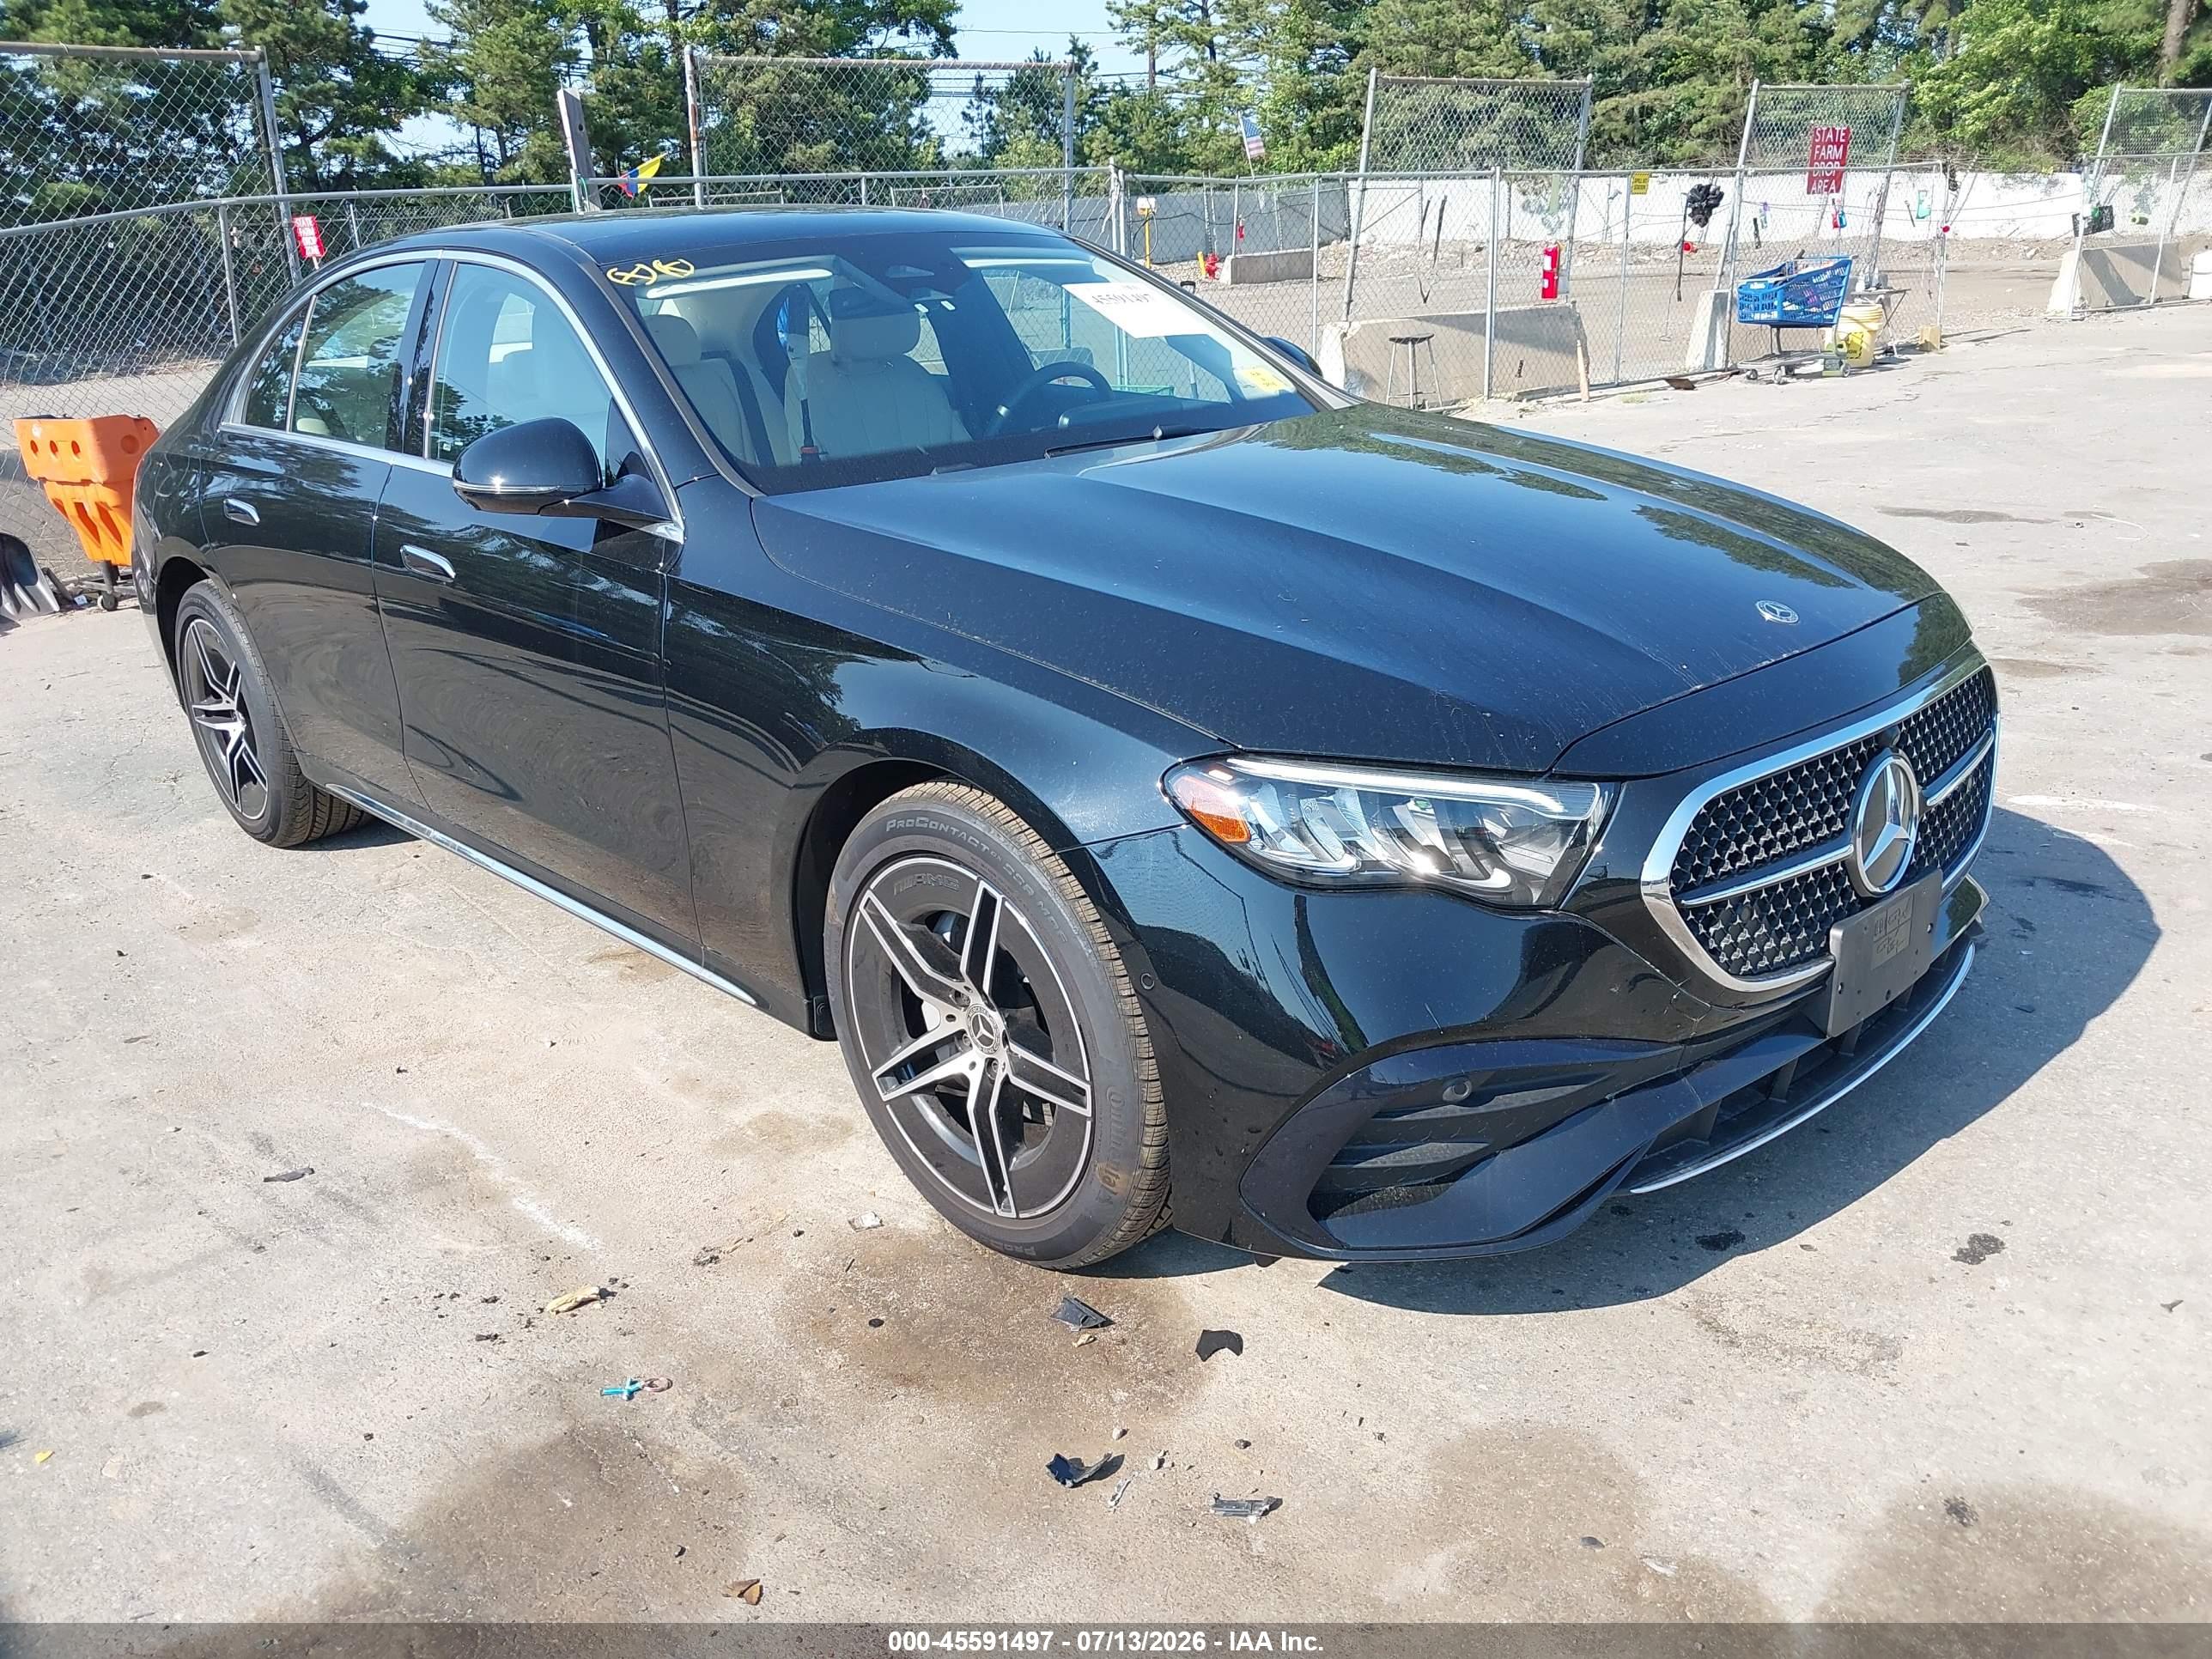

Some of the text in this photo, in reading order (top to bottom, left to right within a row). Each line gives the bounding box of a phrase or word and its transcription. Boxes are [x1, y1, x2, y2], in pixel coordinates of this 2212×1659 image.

[1814, 126, 1847, 143] STATE
[1814, 144, 1844, 161] FARM
[1812, 161, 1841, 178] DROP
[1810, 179, 1837, 194] AREA
